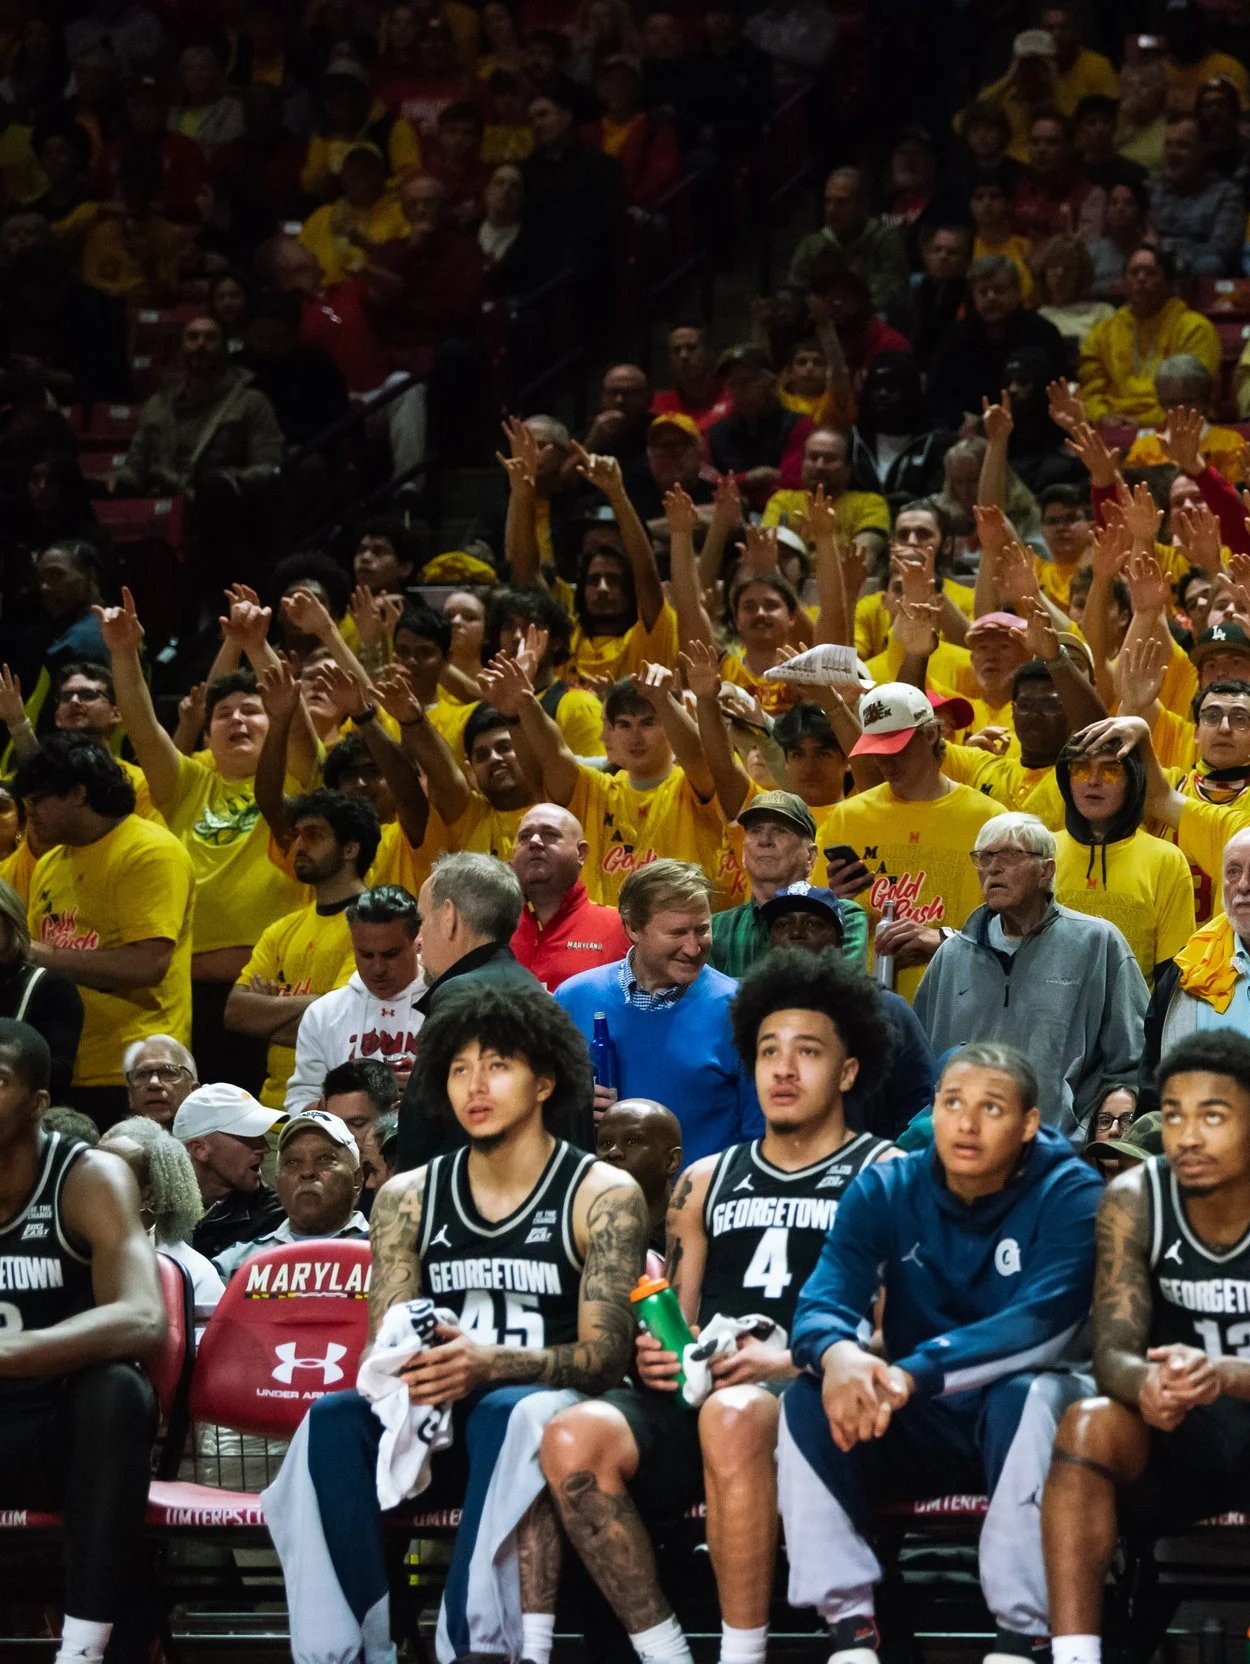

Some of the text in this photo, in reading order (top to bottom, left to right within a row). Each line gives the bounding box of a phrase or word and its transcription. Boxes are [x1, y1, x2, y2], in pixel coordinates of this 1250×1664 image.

[1211, 624, 1227, 641] LA
[870, 871, 927, 912] Gold
[567, 941, 603, 950] MARYLAND
[428, 1257, 562, 1295] GEORGETOWN
[743, 1228, 793, 1299] 4
[994, 1238, 1022, 1276] G
[458, 1290, 546, 1350] 45
[256, 1388, 300, 1399] UNDER
